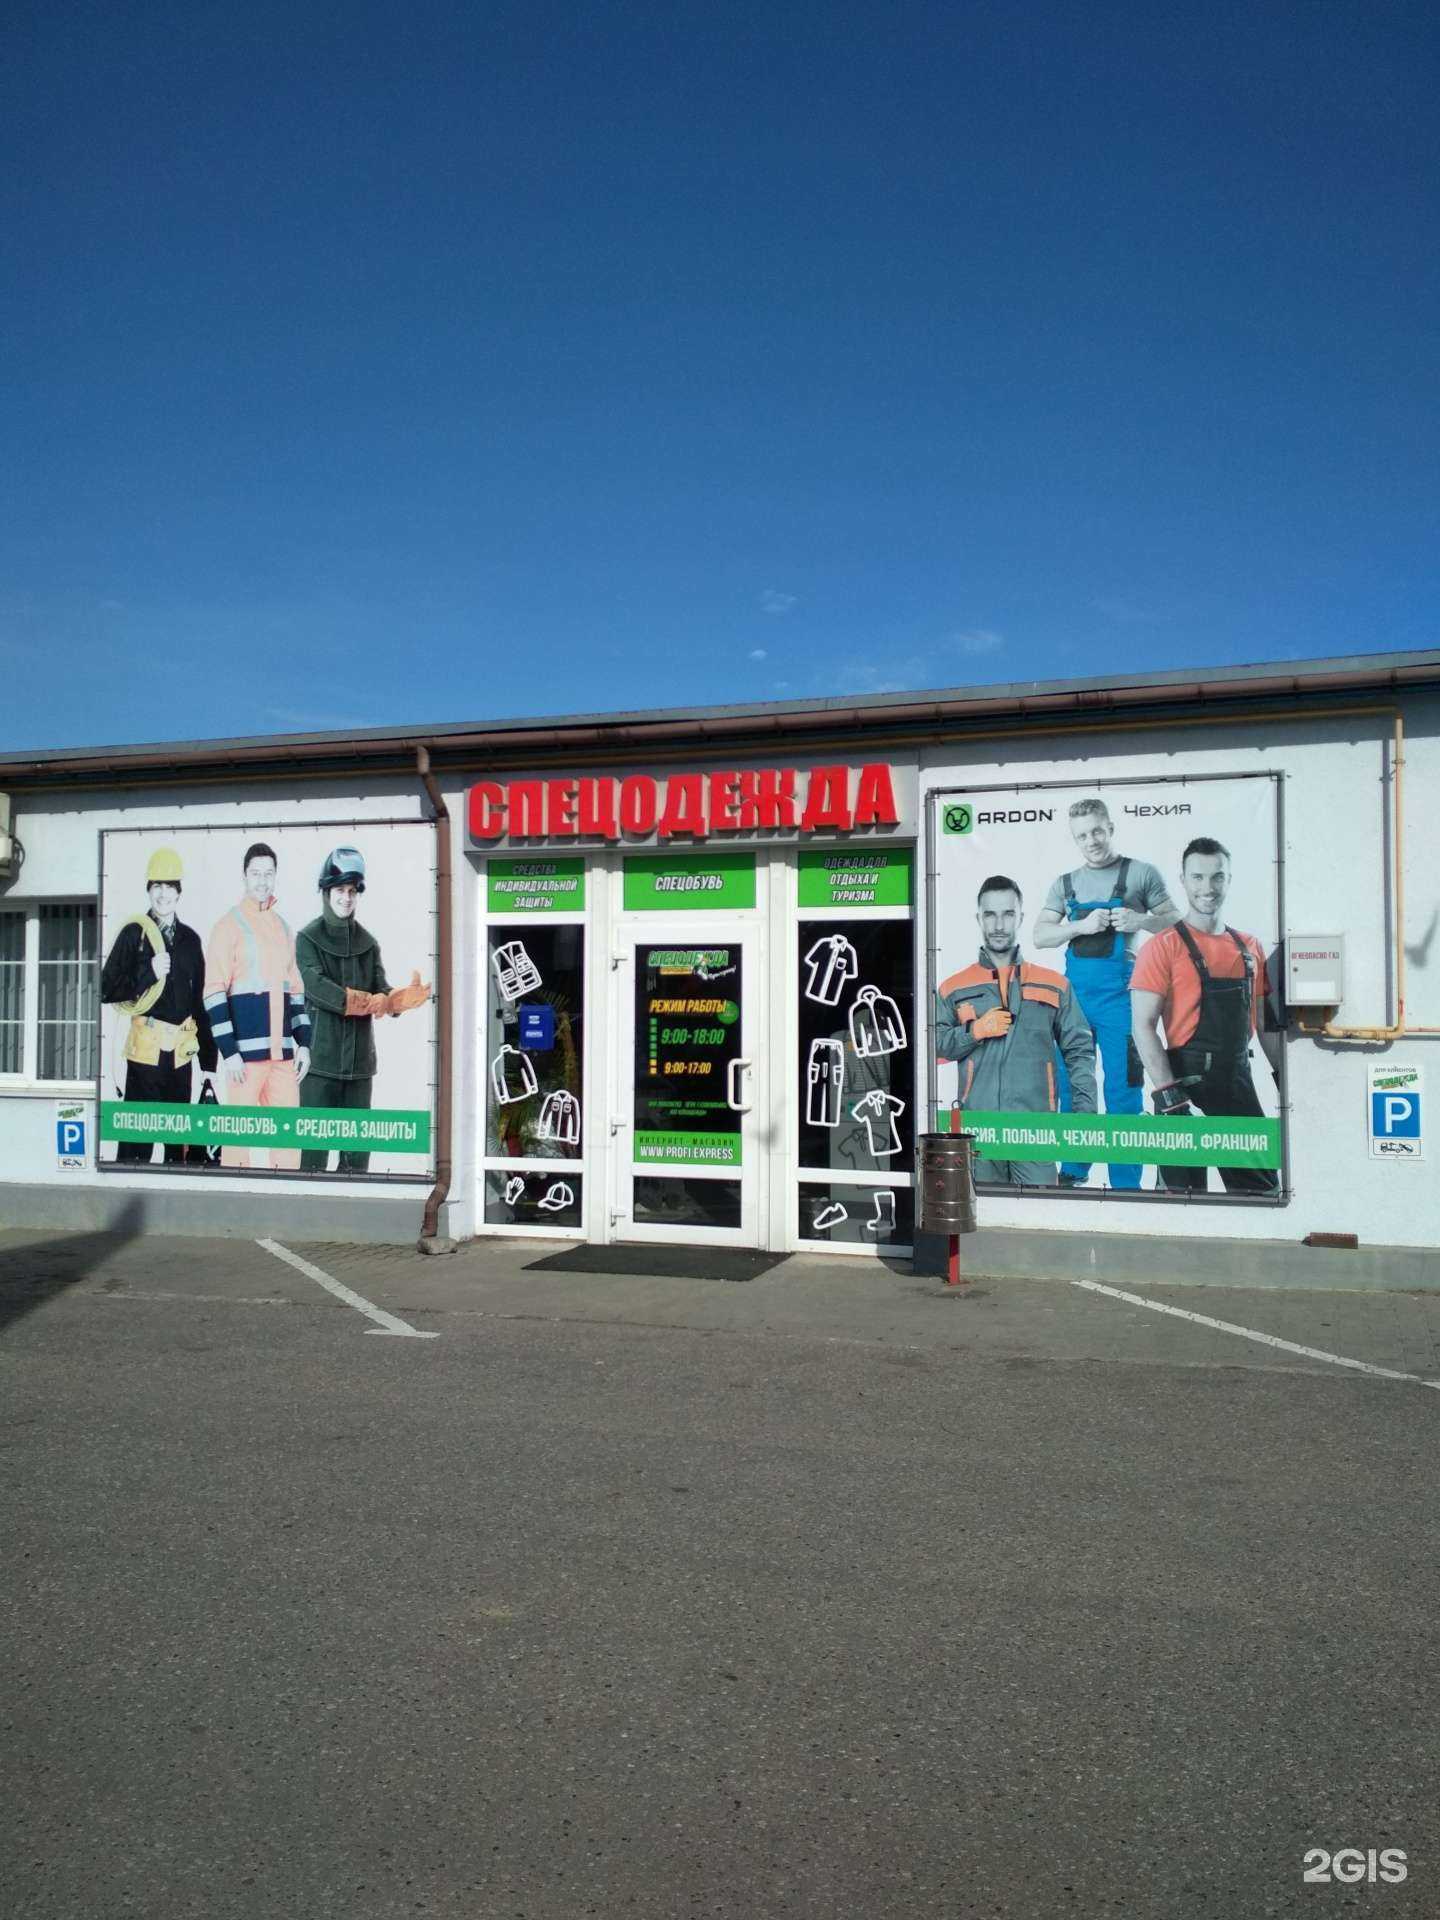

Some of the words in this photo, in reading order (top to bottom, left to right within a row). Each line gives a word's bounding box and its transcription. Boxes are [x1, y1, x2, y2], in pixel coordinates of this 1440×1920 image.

[468, 764, 900, 840] СПЕЦОДЕЖДА
[978, 809, 1052, 824] ARDON
[1124, 803, 1192, 817] Чехия
[512, 864, 556, 877] СРЕДСТВА
[824, 857, 865, 870] ОДЕЖДА
[494, 878, 578, 892] ИНДИВИДУАЛЬНОЙ
[655, 876, 724, 893] СПЕЦОБУВЬ
[830, 873, 870, 886] ОТДЫХА
[871, 873, 880, 884] И
[513, 896, 554, 909] ЗАЩИТЫ
[831, 890, 876, 902] ТУРИЗМА
[650, 999, 687, 1013] РЕЖИМ
[686, 999, 727, 1013] РАБОТЫ
[661, 1028, 725, 1045] 9:00-18:00
[664, 1062, 712, 1074] 9:00-17:00
[1385, 1096, 1412, 1133] P
[113, 1111, 192, 1133] СПЕЦОДЕЖДА
[209, 1115, 277, 1135] СПЕЦОБУВЬ
[296, 1118, 358, 1139] СРЕДСТВА
[360, 1121, 416, 1141] ЗАЩИТЫ
[64, 1123, 80, 1152] P
[1002, 1127, 1060, 1146] ПОЛЬША,
[1063, 1129, 1109, 1148] ЧЕХИЯ,
[1112, 1130, 1197, 1150] ГОЛЛАНДИЯ,
[1200, 1133, 1268, 1152] ФРАНЦИЯ
[640, 1145, 734, 1160] WWW.PROFI.EXPRESS
